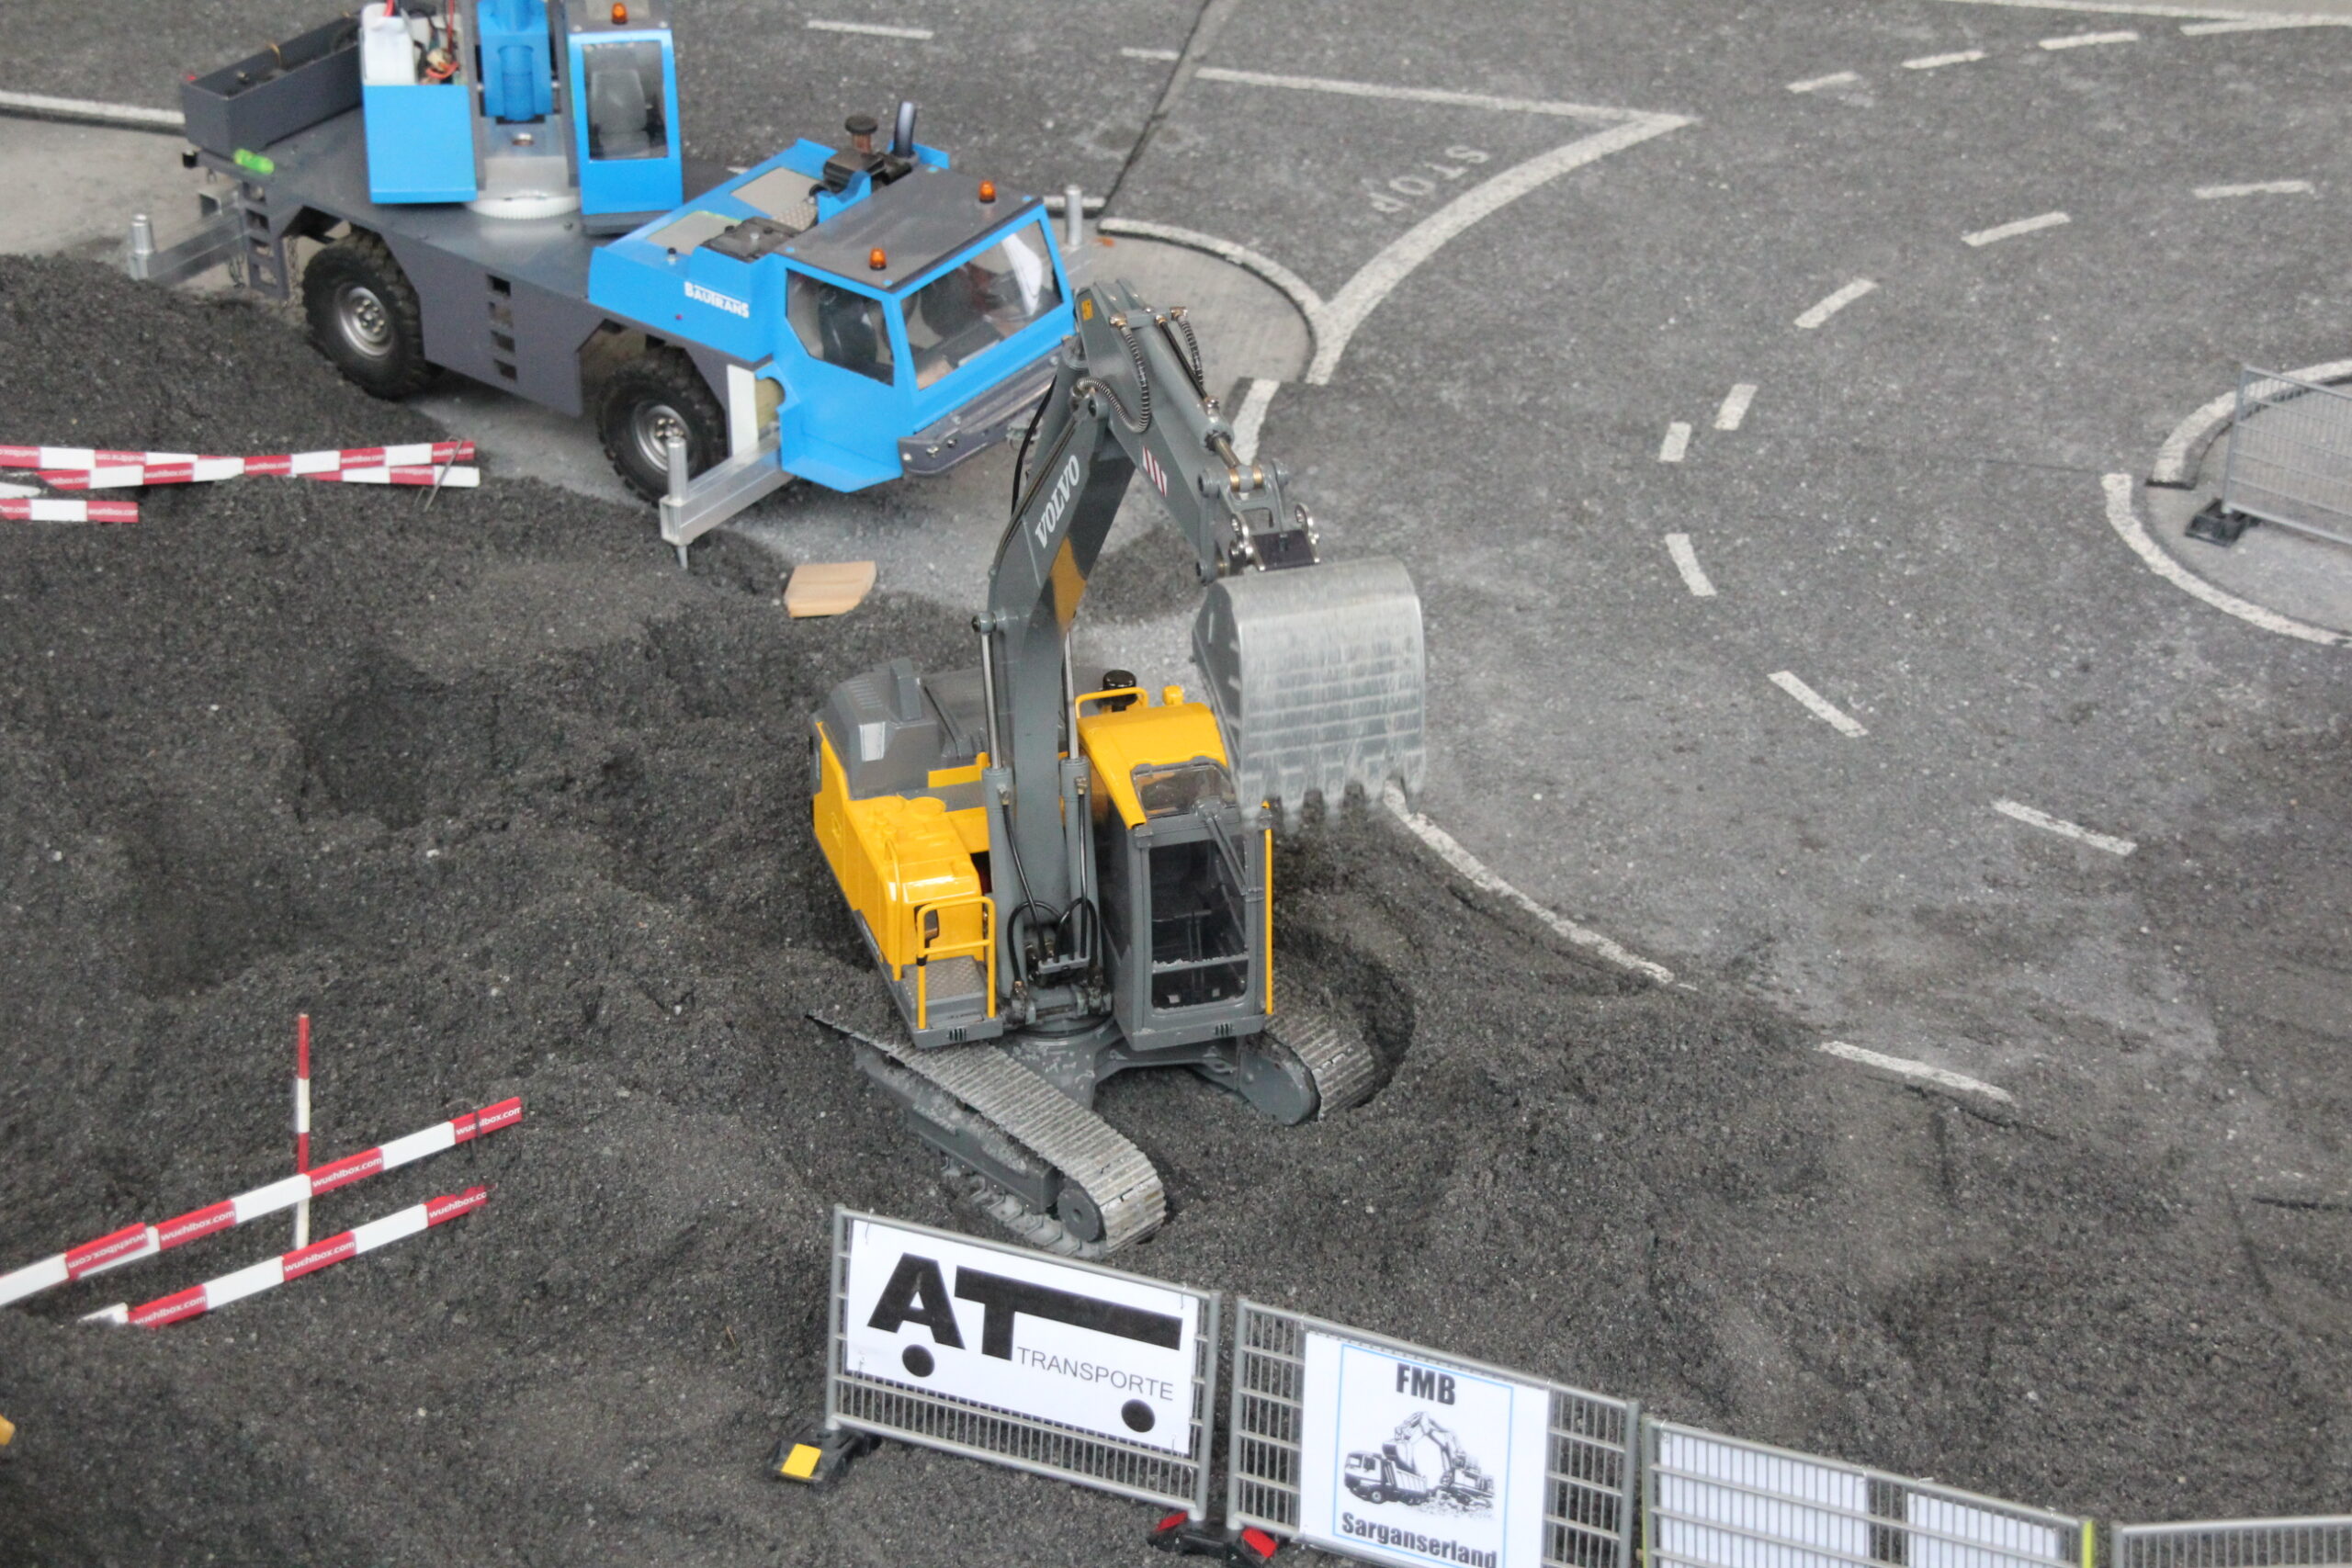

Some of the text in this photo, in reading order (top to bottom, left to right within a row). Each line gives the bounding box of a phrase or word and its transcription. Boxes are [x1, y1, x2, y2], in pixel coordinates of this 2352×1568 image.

[1368, 145, 1490, 213] STOP
[1035, 455, 1080, 548] VOLVO
[312, 1156, 382, 1188] wuehlbox.com
[161, 1209, 235, 1241] wuehlbox.com
[285, 1240, 355, 1272] wuehlbox.com
[867, 1252, 1182, 1361] AT
[1017, 1347, 1174, 1402] TRANSPORTE
[1396, 1362, 1455, 1406] FMB
[1341, 1511, 1498, 1568] Sarganserland
